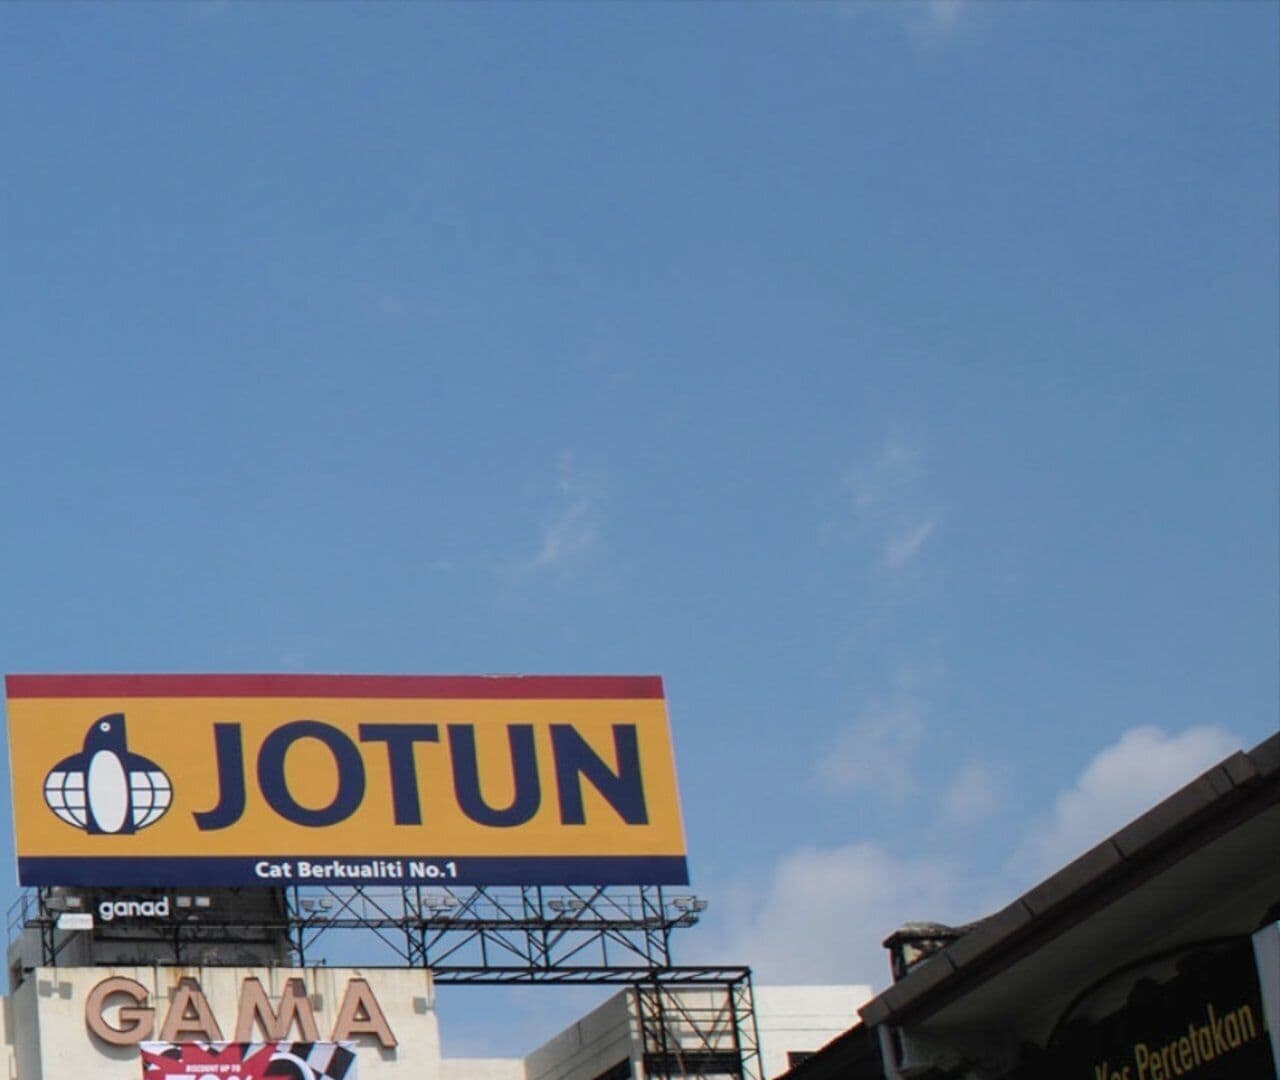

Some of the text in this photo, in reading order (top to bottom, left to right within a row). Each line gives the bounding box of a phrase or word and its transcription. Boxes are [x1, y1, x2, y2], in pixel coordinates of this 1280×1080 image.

[192, 719, 650, 830] JOTUN
[254, 860, 458, 879] Cat Berkualiti No.1
[99, 896, 170, 921] ganad
[85, 976, 398, 1049] GAMA
